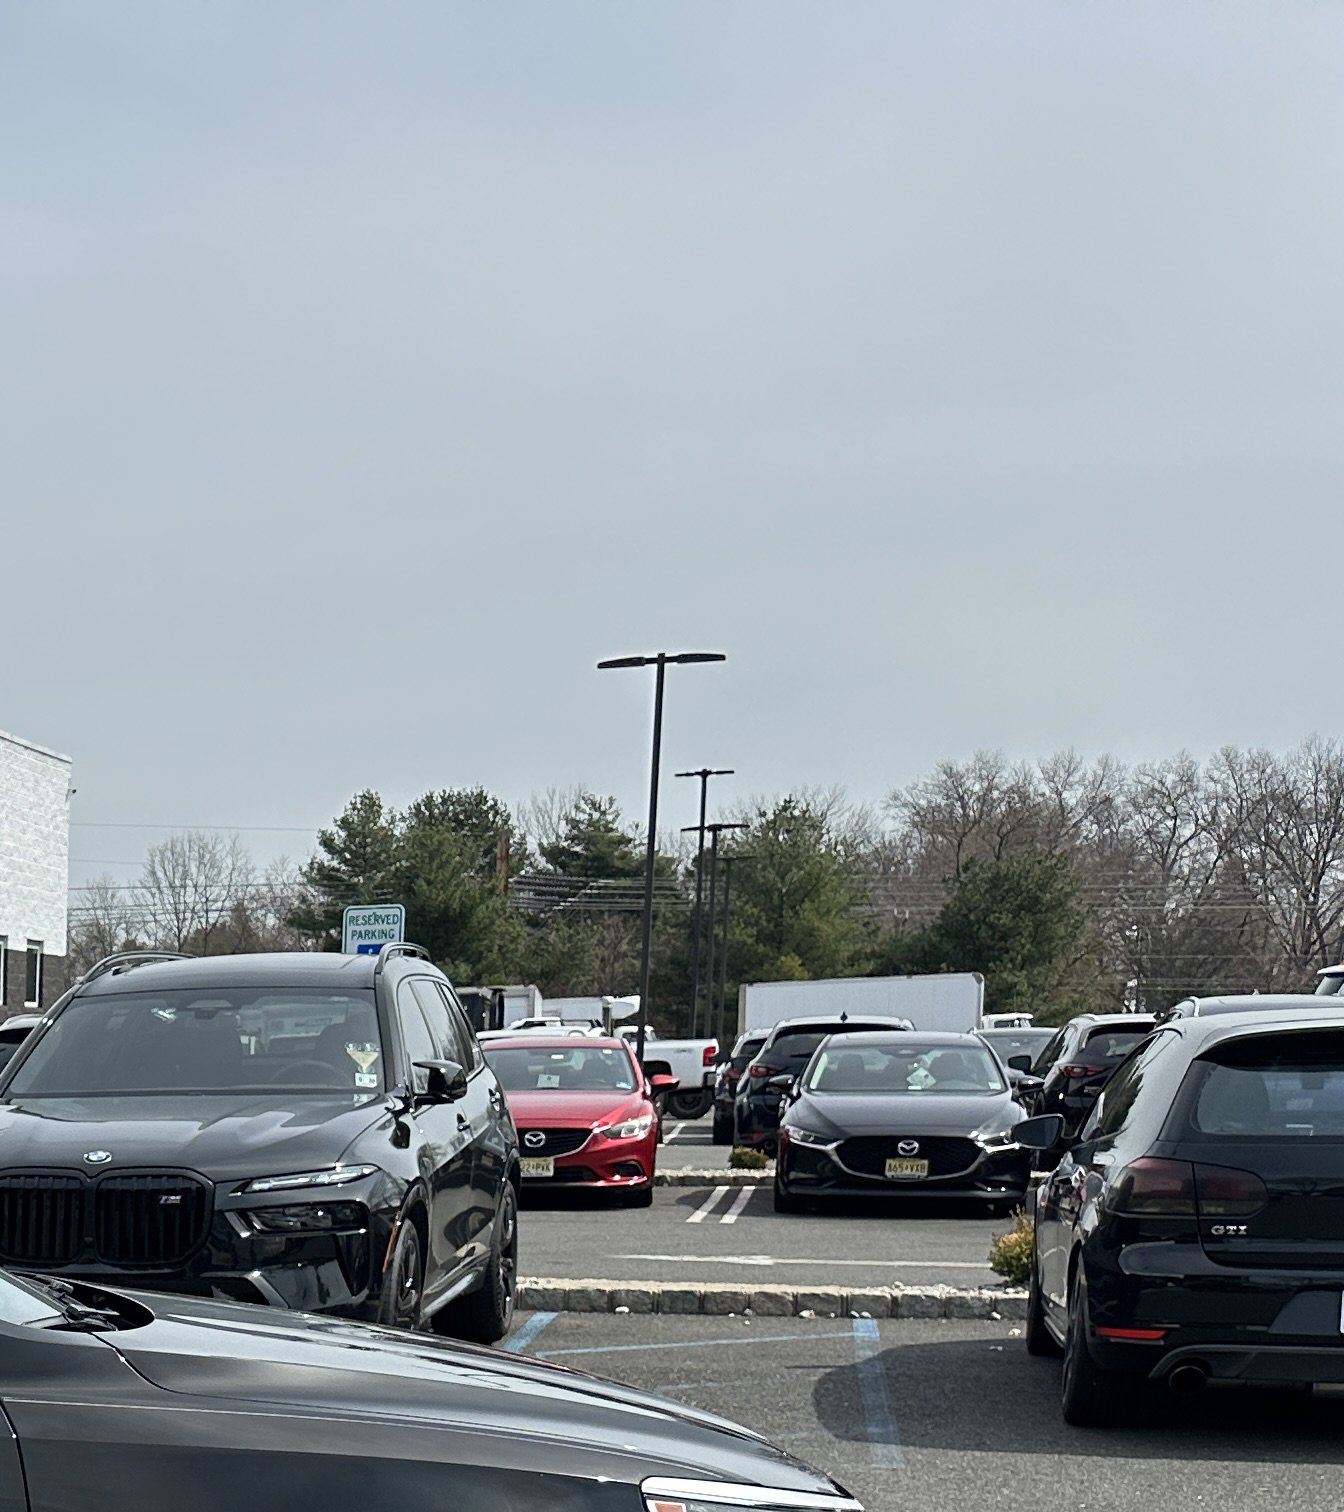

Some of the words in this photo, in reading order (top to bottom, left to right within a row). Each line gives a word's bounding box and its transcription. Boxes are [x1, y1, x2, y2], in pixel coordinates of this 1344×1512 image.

[348, 913, 399, 926] RESERVED
[351, 928, 395, 940] PARKING
[1211, 1225, 1248, 1235] GTI
